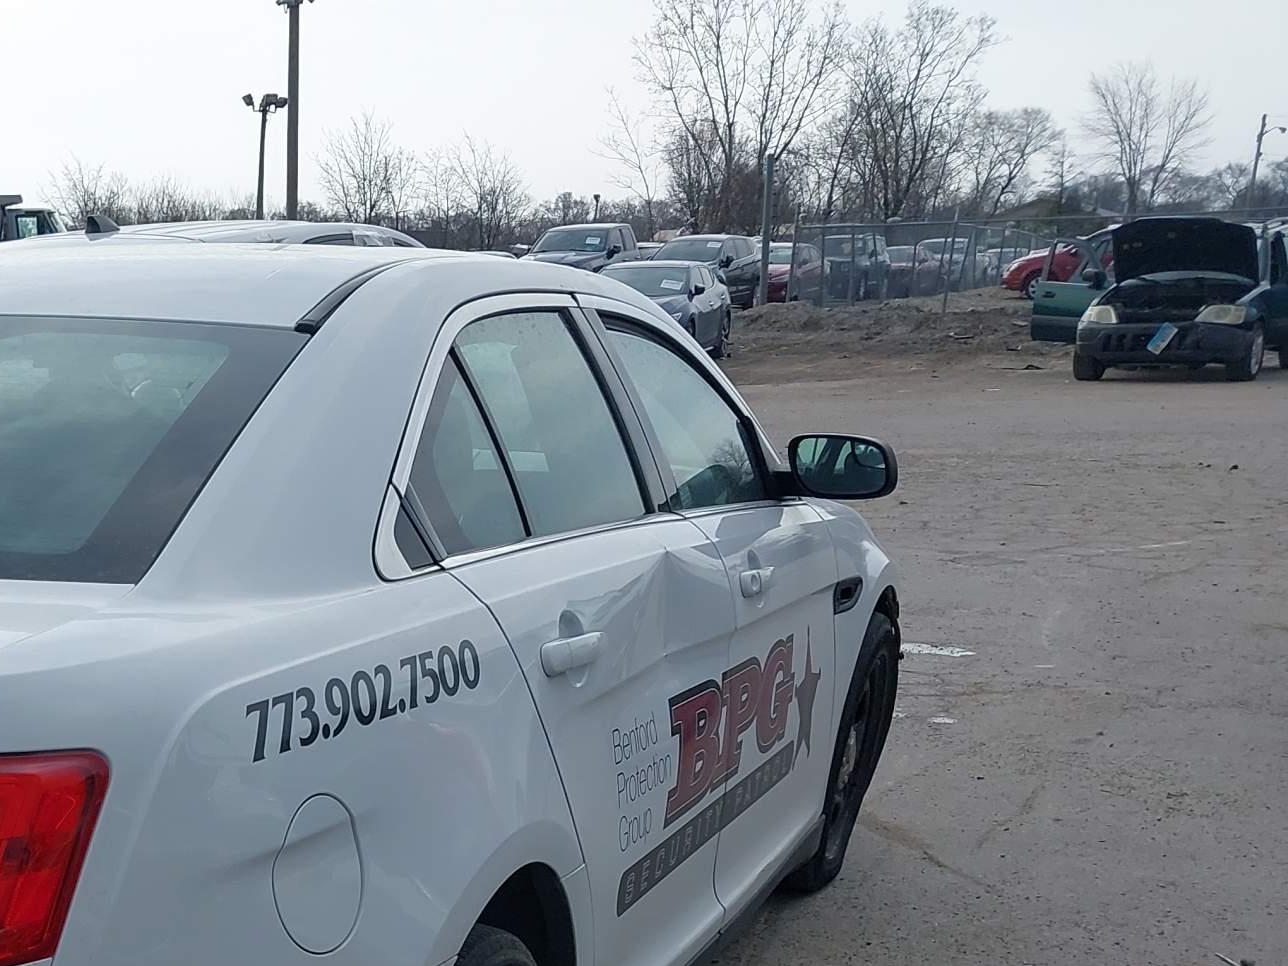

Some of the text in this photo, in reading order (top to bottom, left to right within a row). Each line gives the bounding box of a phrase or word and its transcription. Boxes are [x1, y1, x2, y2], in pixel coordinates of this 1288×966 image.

[245, 639, 480, 763] 773.902.7500
[612, 714, 658, 766] Benford
[663, 634, 795, 830] BPG
[616, 754, 672, 809] Protection
[618, 808, 653, 852] Group
[623, 799, 725, 904] SECURITY
